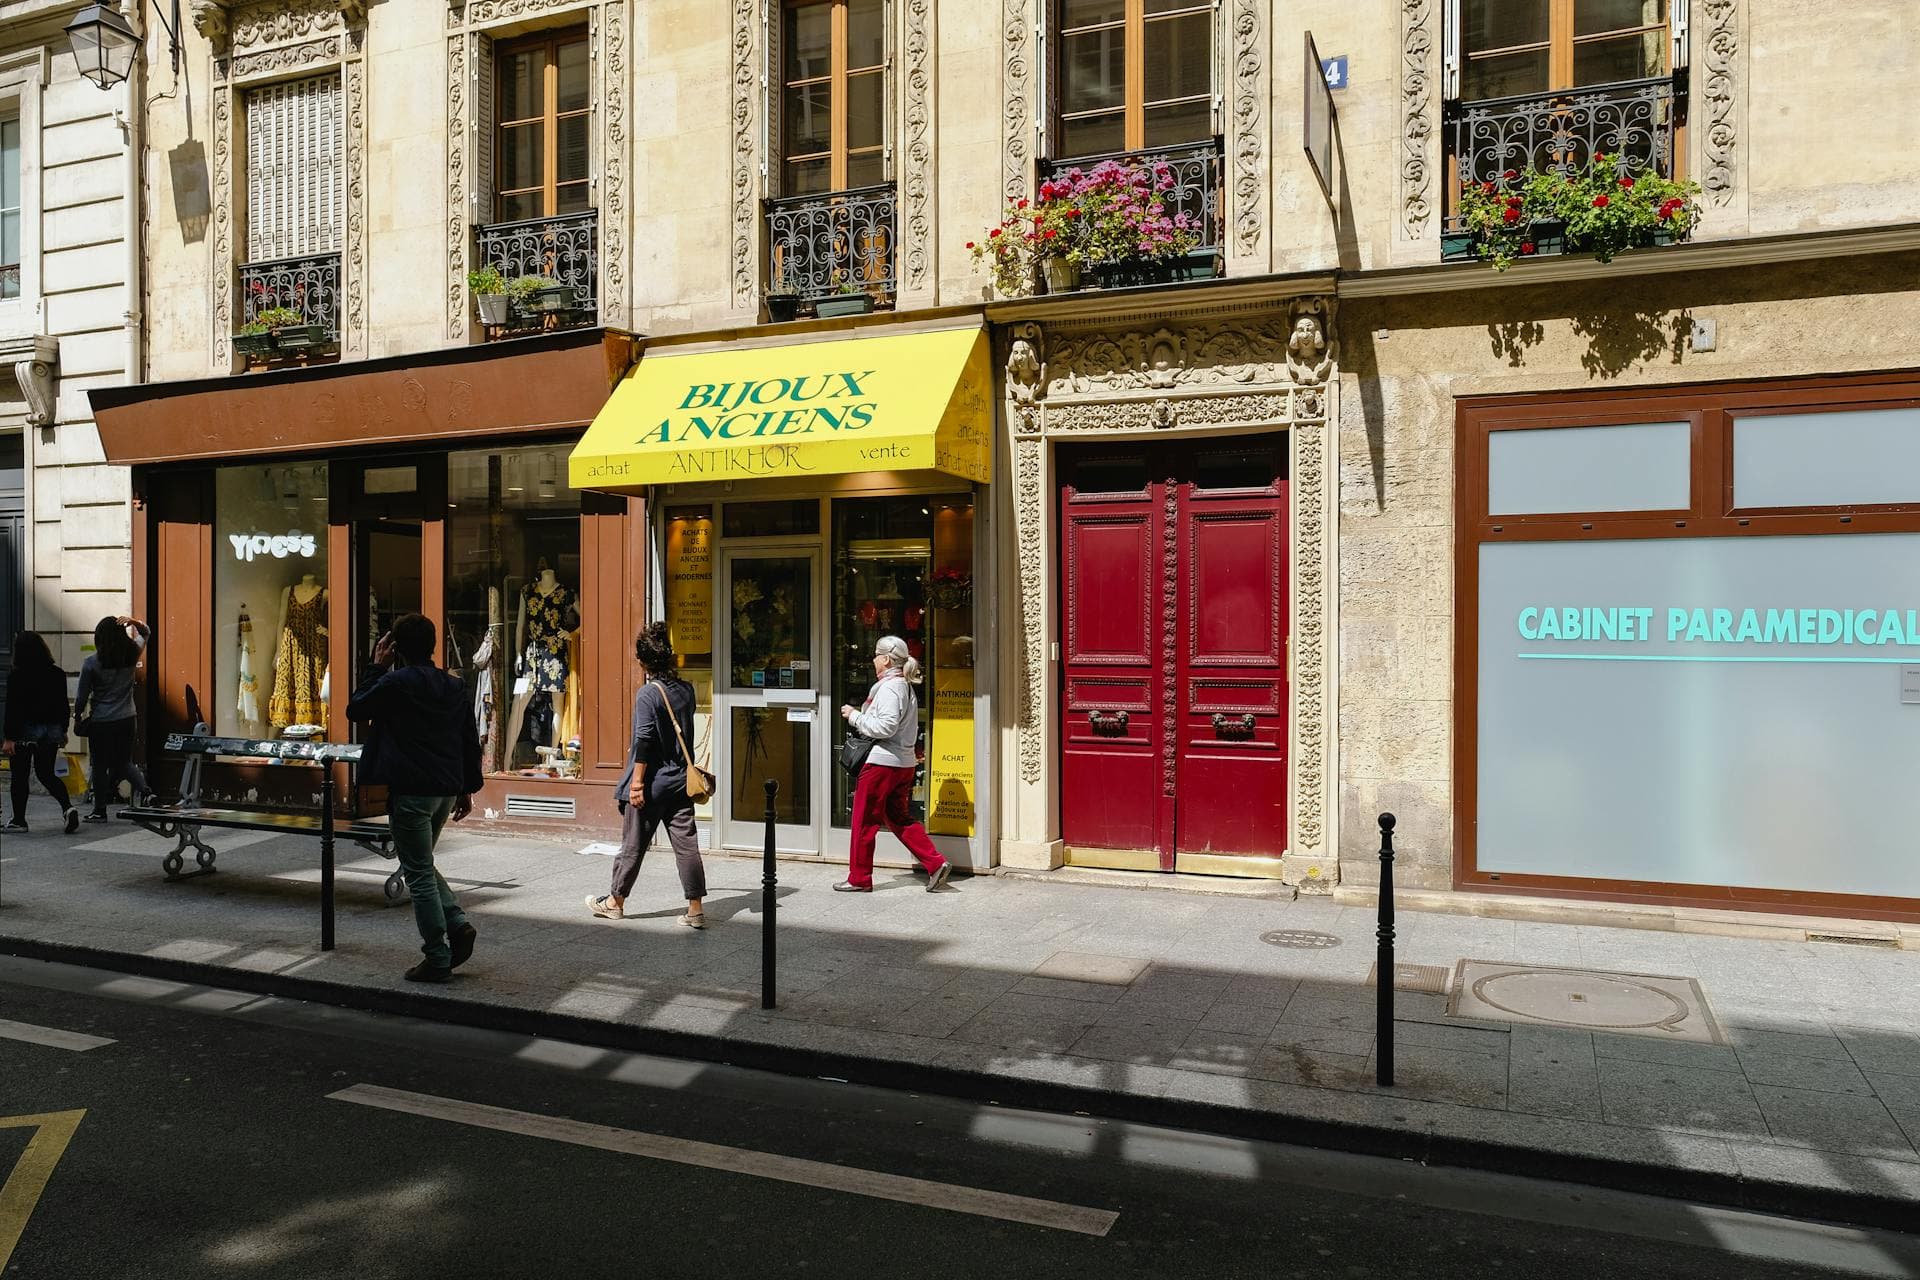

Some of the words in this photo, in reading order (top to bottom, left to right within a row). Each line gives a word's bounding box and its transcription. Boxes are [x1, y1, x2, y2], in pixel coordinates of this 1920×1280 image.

[1325, 61, 1341, 85] 4
[677, 370, 877, 413] BIJOUX
[634, 403, 879, 445] ANCIENS
[588, 456, 632, 477] achat
[669, 444, 817, 475] ANTIKHOR
[859, 442, 911, 460] vente
[936, 440, 961, 472] achat
[681, 528, 709, 537] ACHATS
[1518, 607, 1654, 641] CABINET
[1668, 608, 1920, 645] PARAMEDICAL
